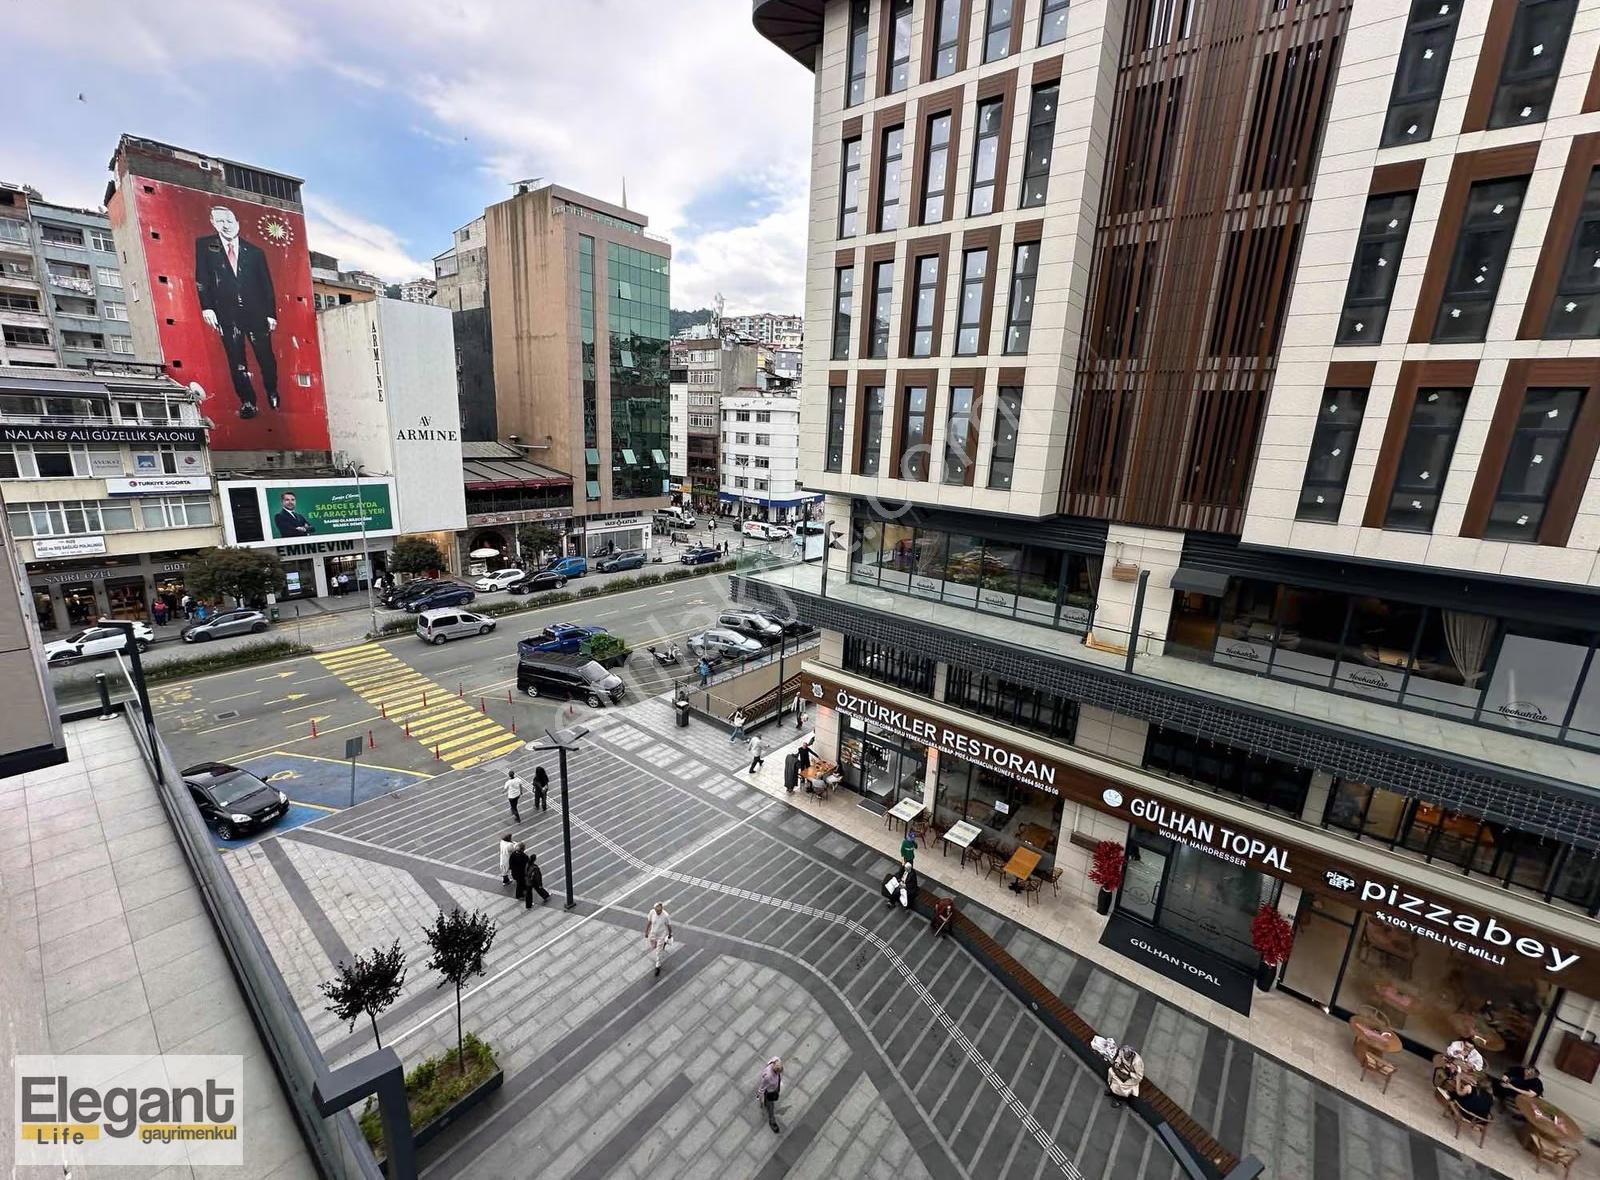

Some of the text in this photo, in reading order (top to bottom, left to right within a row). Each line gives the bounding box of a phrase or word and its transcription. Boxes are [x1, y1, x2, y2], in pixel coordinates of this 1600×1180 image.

[4, 429, 55, 440] NALAN
[57, 431, 67, 440] &
[92, 429, 148, 441] GÜZELLİK
[149, 431, 196, 442] SALONU
[396, 429, 458, 441] ARMINE
[315, 503, 348, 511] SADECE
[323, 510, 347, 518] ARAÇ
[836, 688, 1056, 784] ÖZTÜRKLER RESTORAN
[1130, 798, 1292, 873] GÜLHAN TOPAL
[1159, 828, 1188, 845] WOMAN
[1360, 880, 1581, 972] pizzabey
[1375, 911, 1407, 928] %100
[1449, 938, 1467, 951] VE
[1130, 937, 1221, 987] GÜLHAN TOPAL
